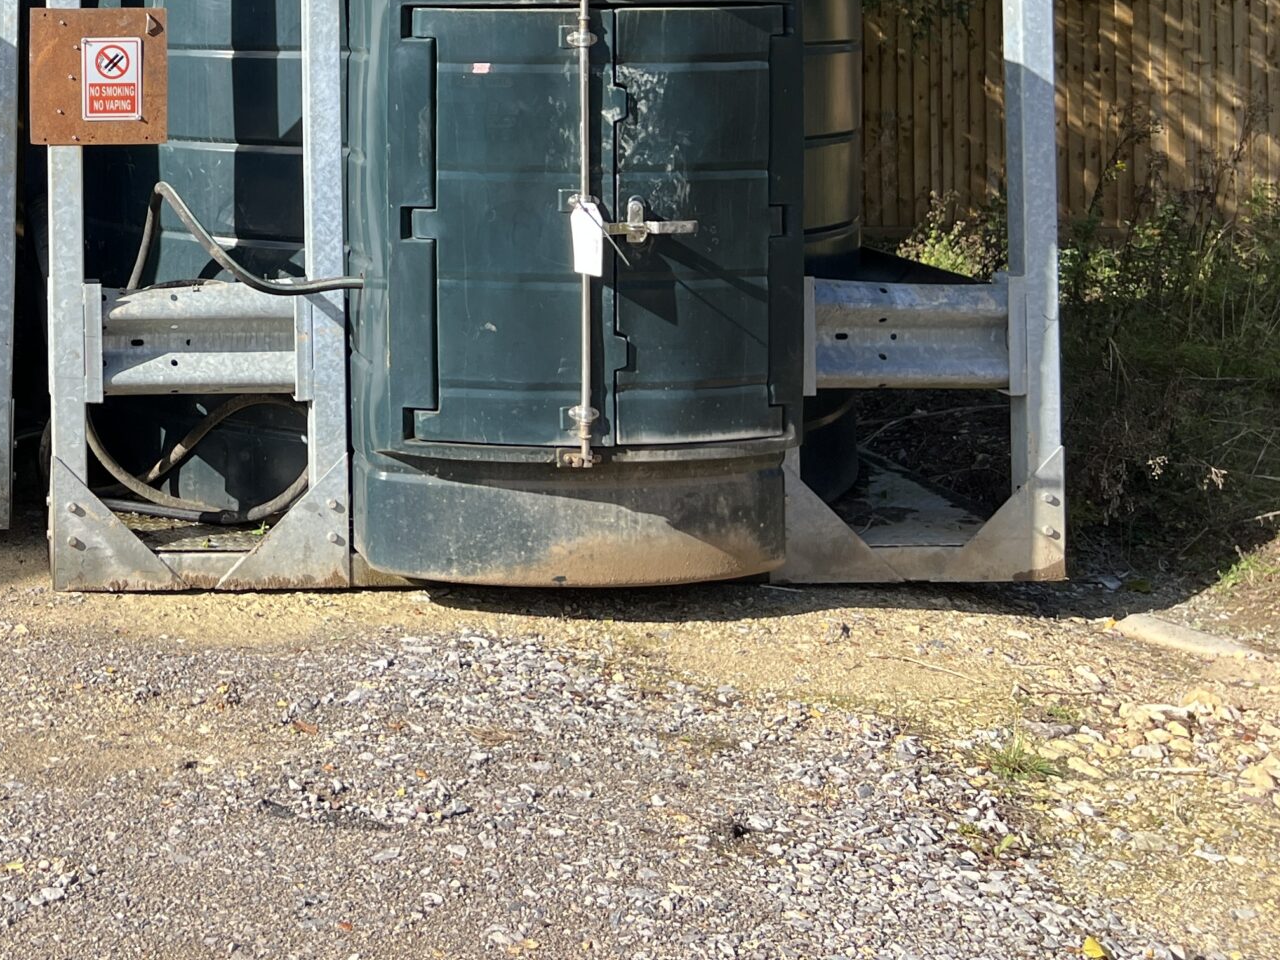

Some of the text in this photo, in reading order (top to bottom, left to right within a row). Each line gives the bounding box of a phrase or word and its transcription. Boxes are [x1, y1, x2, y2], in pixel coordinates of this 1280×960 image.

[89, 86, 135, 97] NO SMOKING
[93, 99, 132, 111] NO VAPING
